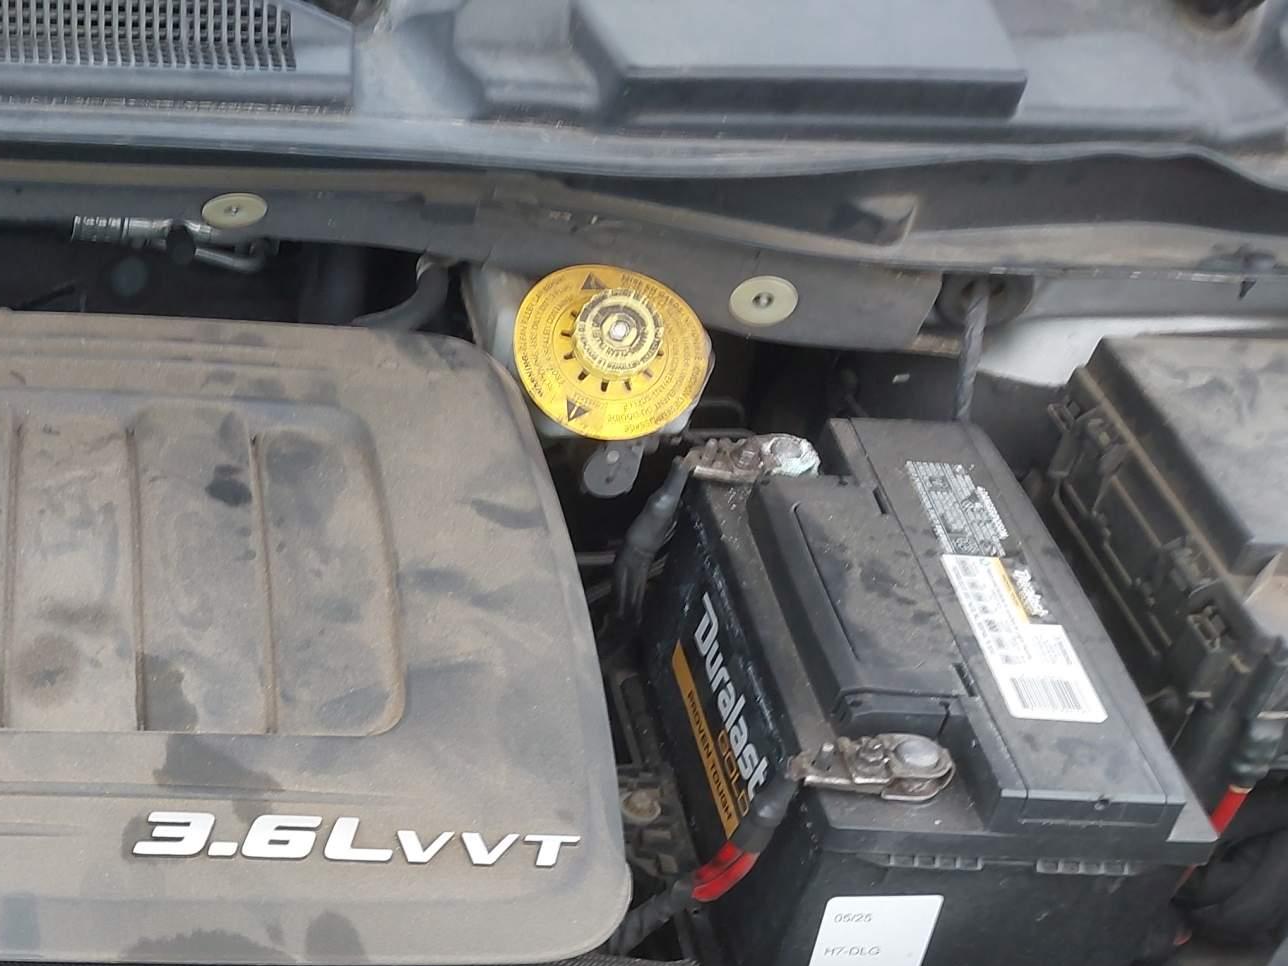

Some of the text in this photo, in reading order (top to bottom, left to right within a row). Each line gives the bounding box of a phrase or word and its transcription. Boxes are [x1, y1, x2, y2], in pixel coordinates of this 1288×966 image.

[694, 592, 769, 800] Duralast
[686, 688, 733, 822] PROVEN TOUGH
[717, 730, 750, 817] GOLD
[132, 811, 582, 867] 3.6L VVT
